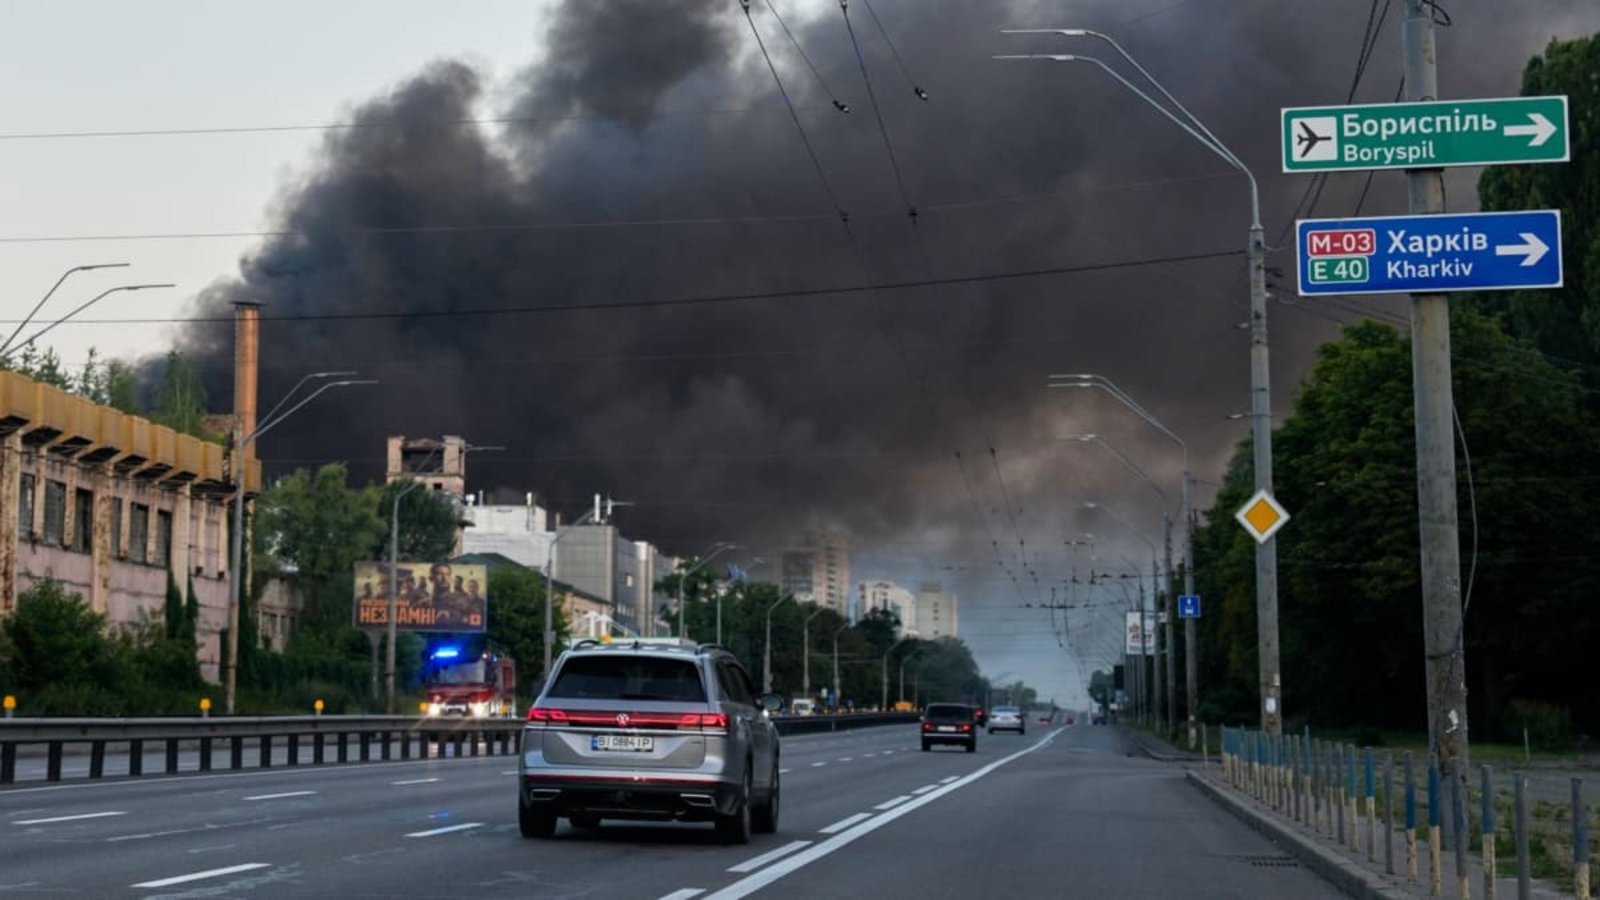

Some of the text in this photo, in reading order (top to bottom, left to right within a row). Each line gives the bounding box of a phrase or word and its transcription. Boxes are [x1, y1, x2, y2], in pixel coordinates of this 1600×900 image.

[1343, 108, 1497, 140] Бориспіль
[1343, 140, 1436, 164] Boryspil
[1311, 232, 1372, 254] M-03
[1387, 226, 1488, 258] Харків
[1313, 259, 1363, 280] E 40
[1387, 258, 1473, 279] Kharkiv
